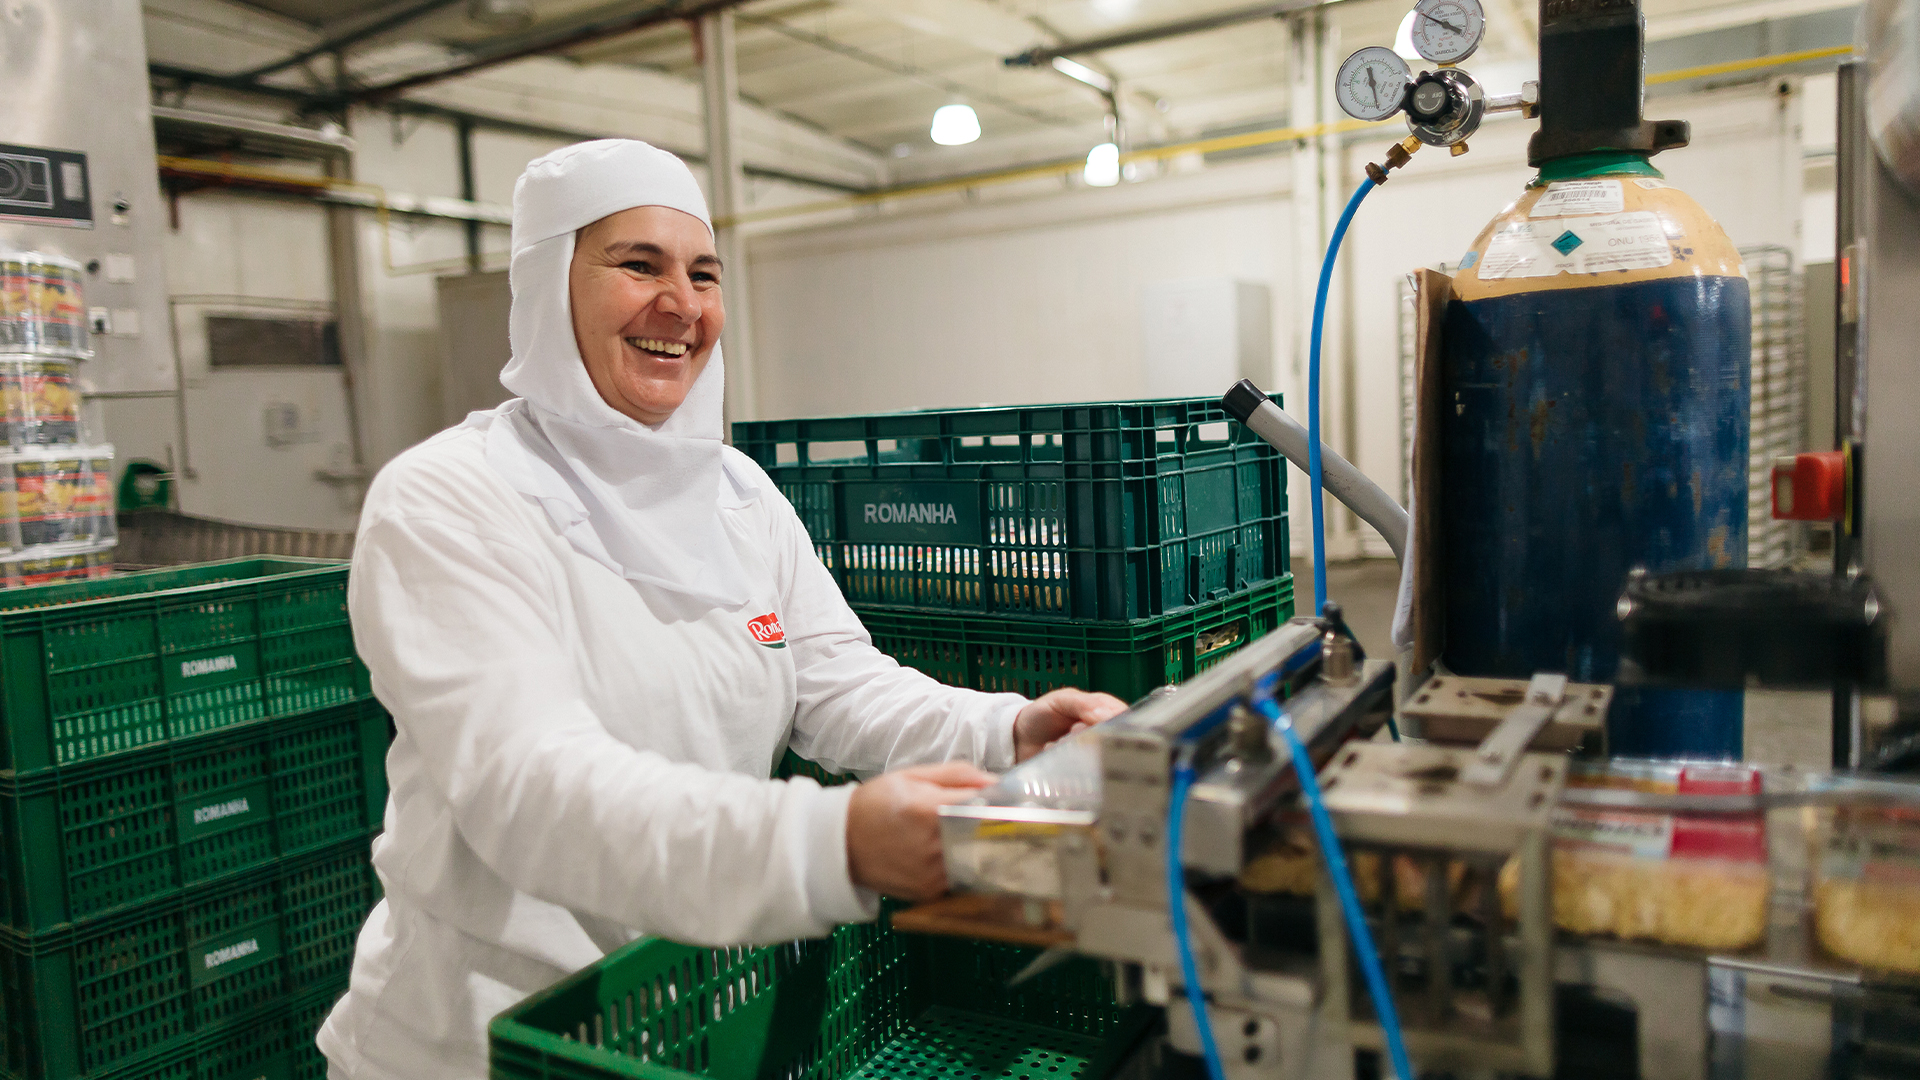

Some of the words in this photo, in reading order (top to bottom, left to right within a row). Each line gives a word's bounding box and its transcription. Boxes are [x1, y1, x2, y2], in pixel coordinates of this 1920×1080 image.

[1608, 236, 1634, 247] ONU
[1638, 234, 1662, 244] 1956
[864, 503, 957, 524] ROMANHA
[181, 654, 237, 678] ROMANHA
[194, 797, 250, 825] ROMANHA
[205, 938, 259, 970] ROMANHA
